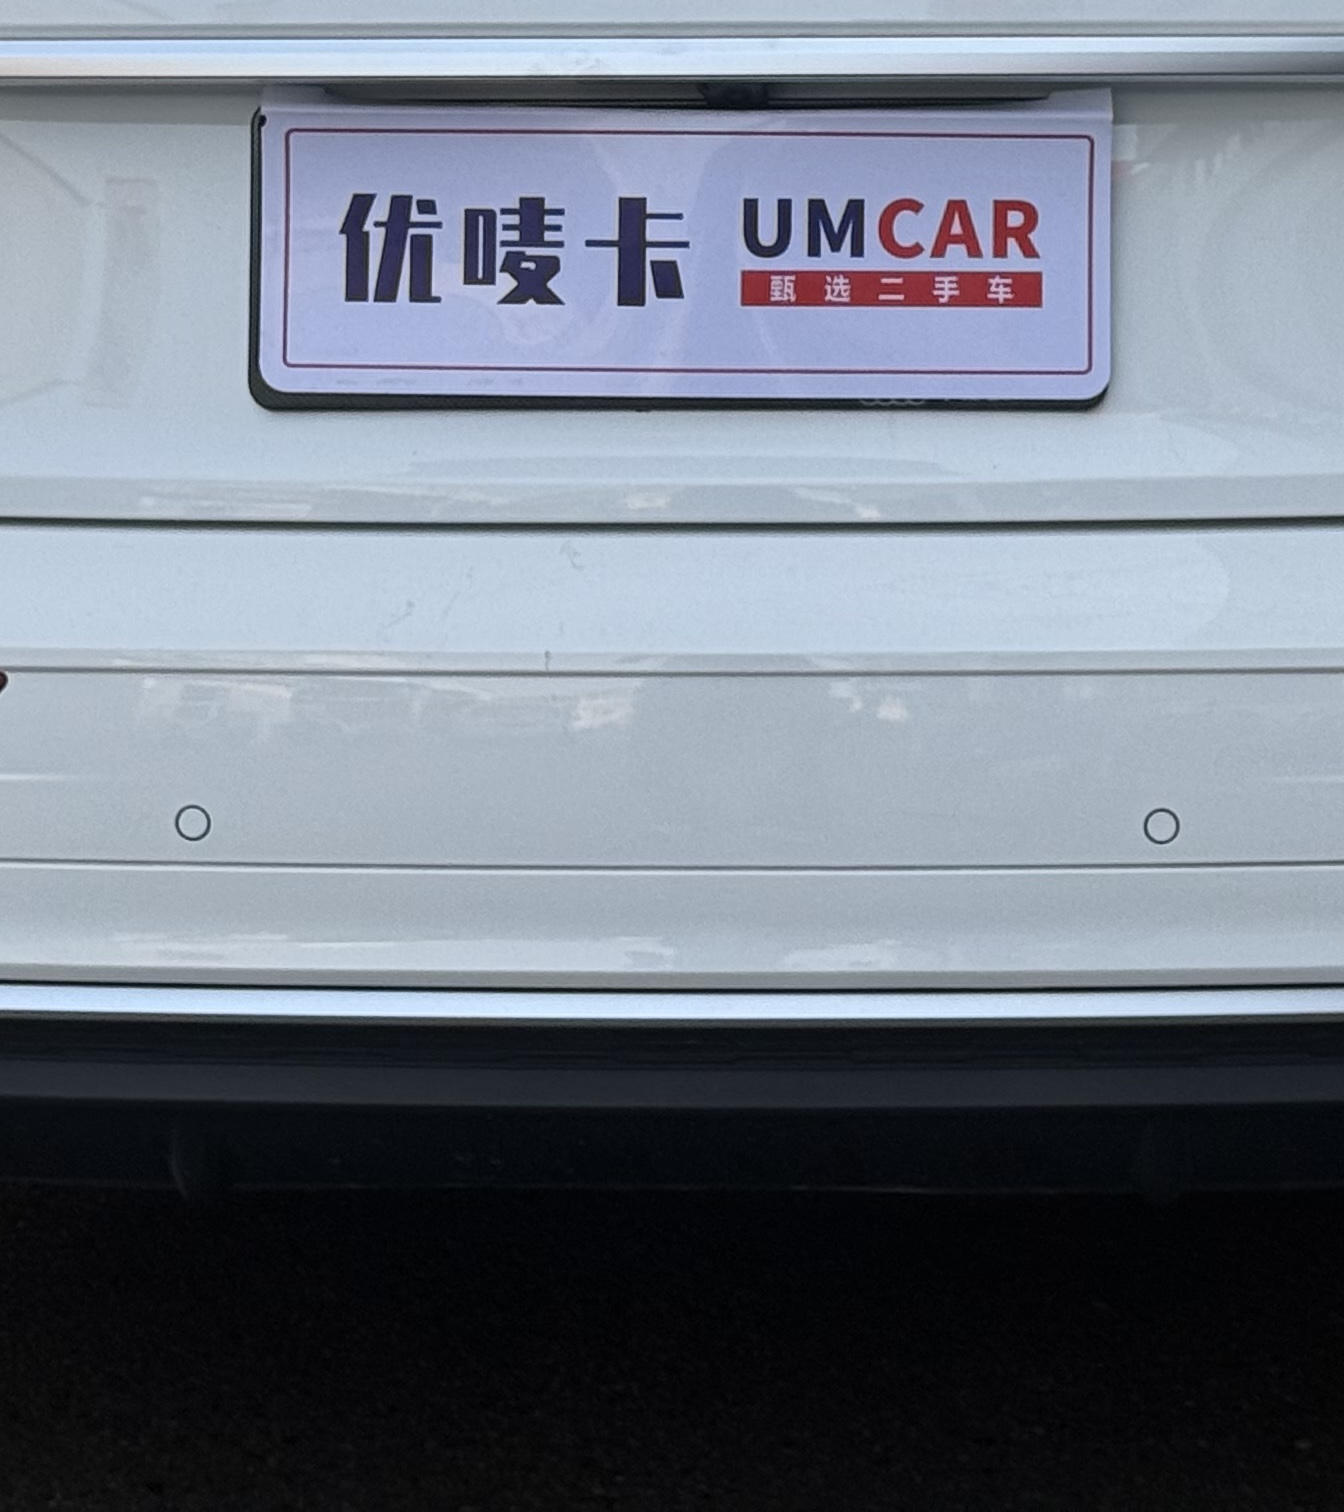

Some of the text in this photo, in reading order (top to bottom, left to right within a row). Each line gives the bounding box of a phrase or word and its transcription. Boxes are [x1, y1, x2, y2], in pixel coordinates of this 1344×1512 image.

[340, 192, 691, 307] 优唛卡
[742, 197, 1042, 260] UMCAR
[769, 273, 1016, 304] 甄选二手车
